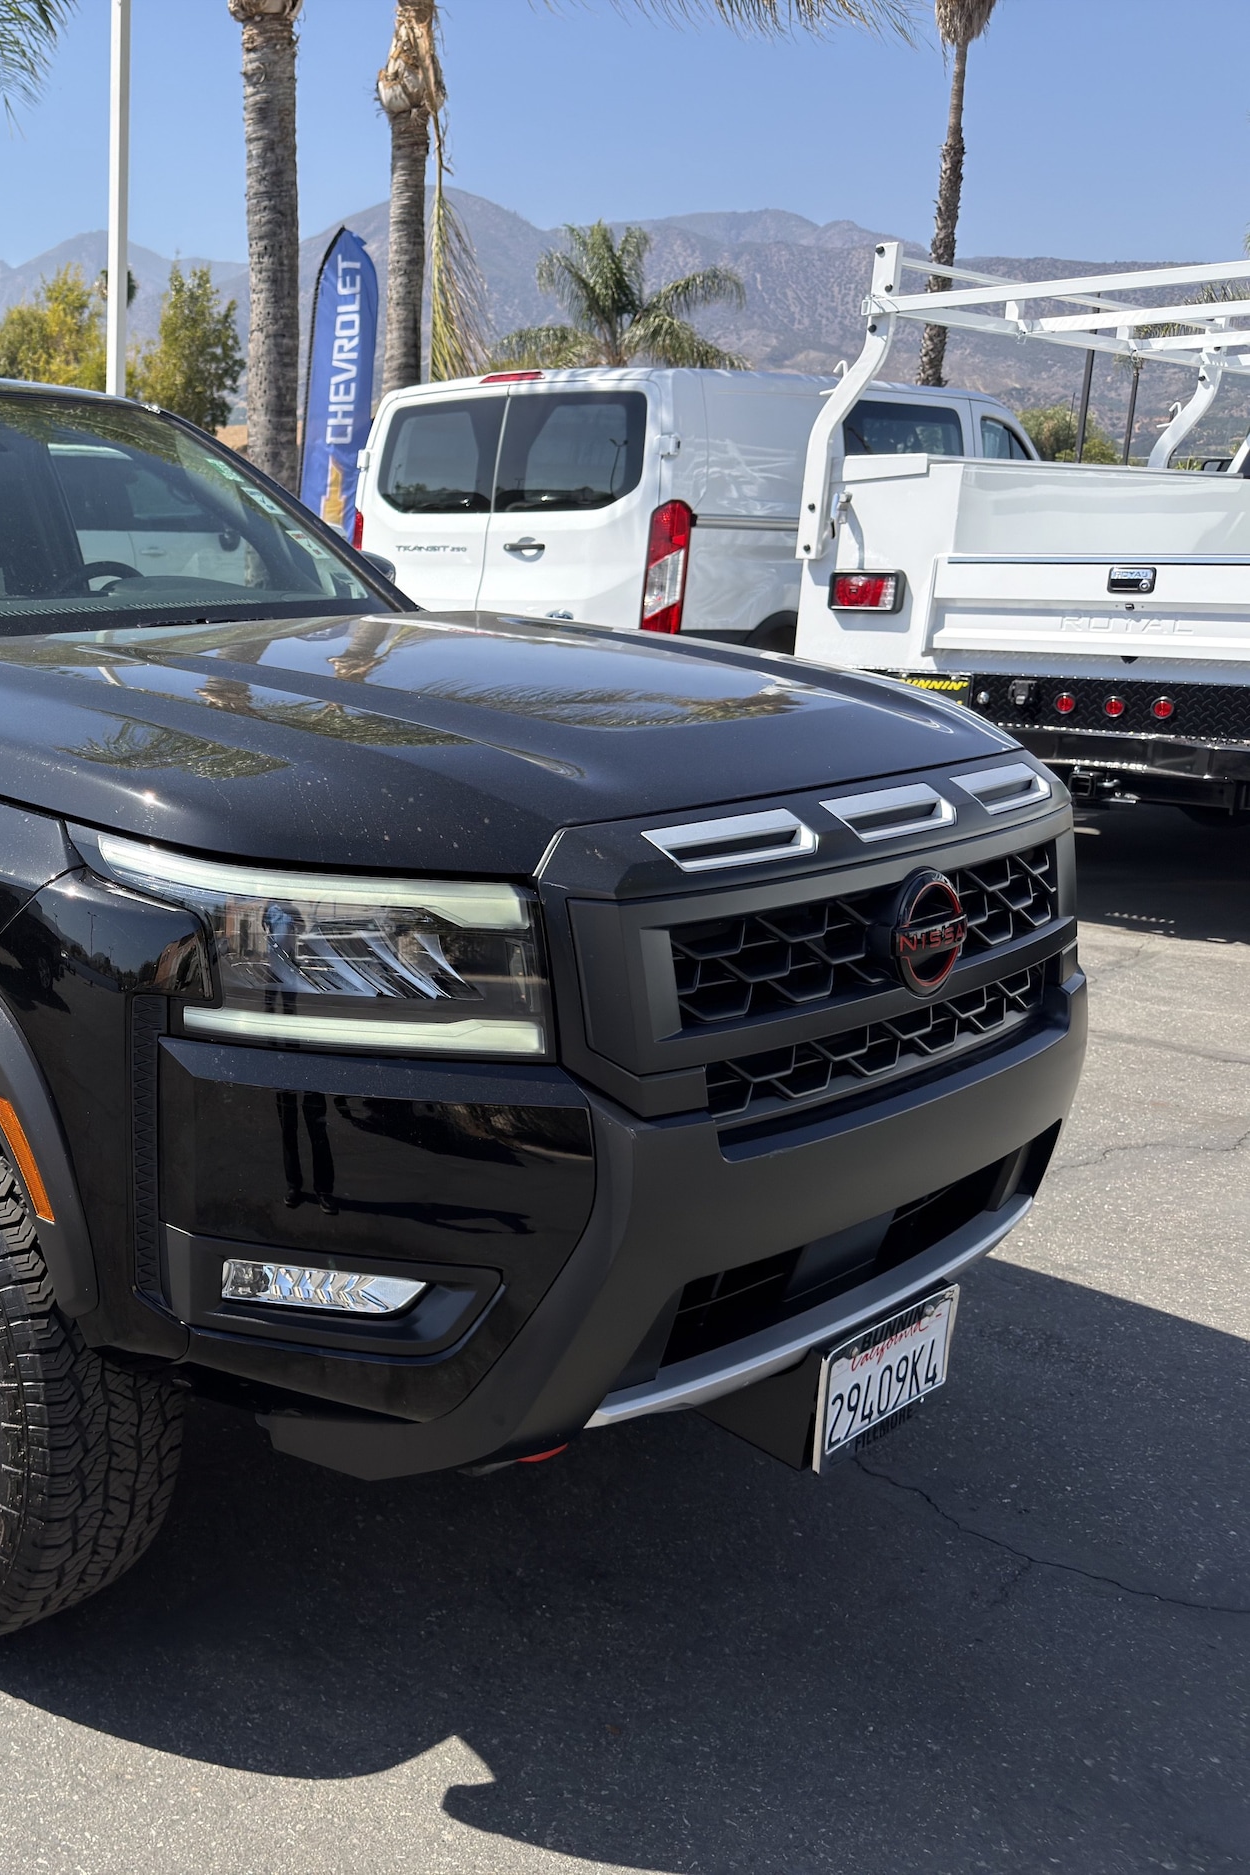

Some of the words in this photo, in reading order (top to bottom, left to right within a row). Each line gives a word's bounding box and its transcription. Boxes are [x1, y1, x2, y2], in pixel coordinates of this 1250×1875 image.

[325, 254, 362, 445] CHEVROLET
[1112, 569, 1149, 579] ROYAL
[1060, 610, 1196, 635] ROYAL
[898, 922, 965, 953] NISSA
[860, 1302, 926, 1351] BUNNIN
[827, 1338, 938, 1450] 29409K4
